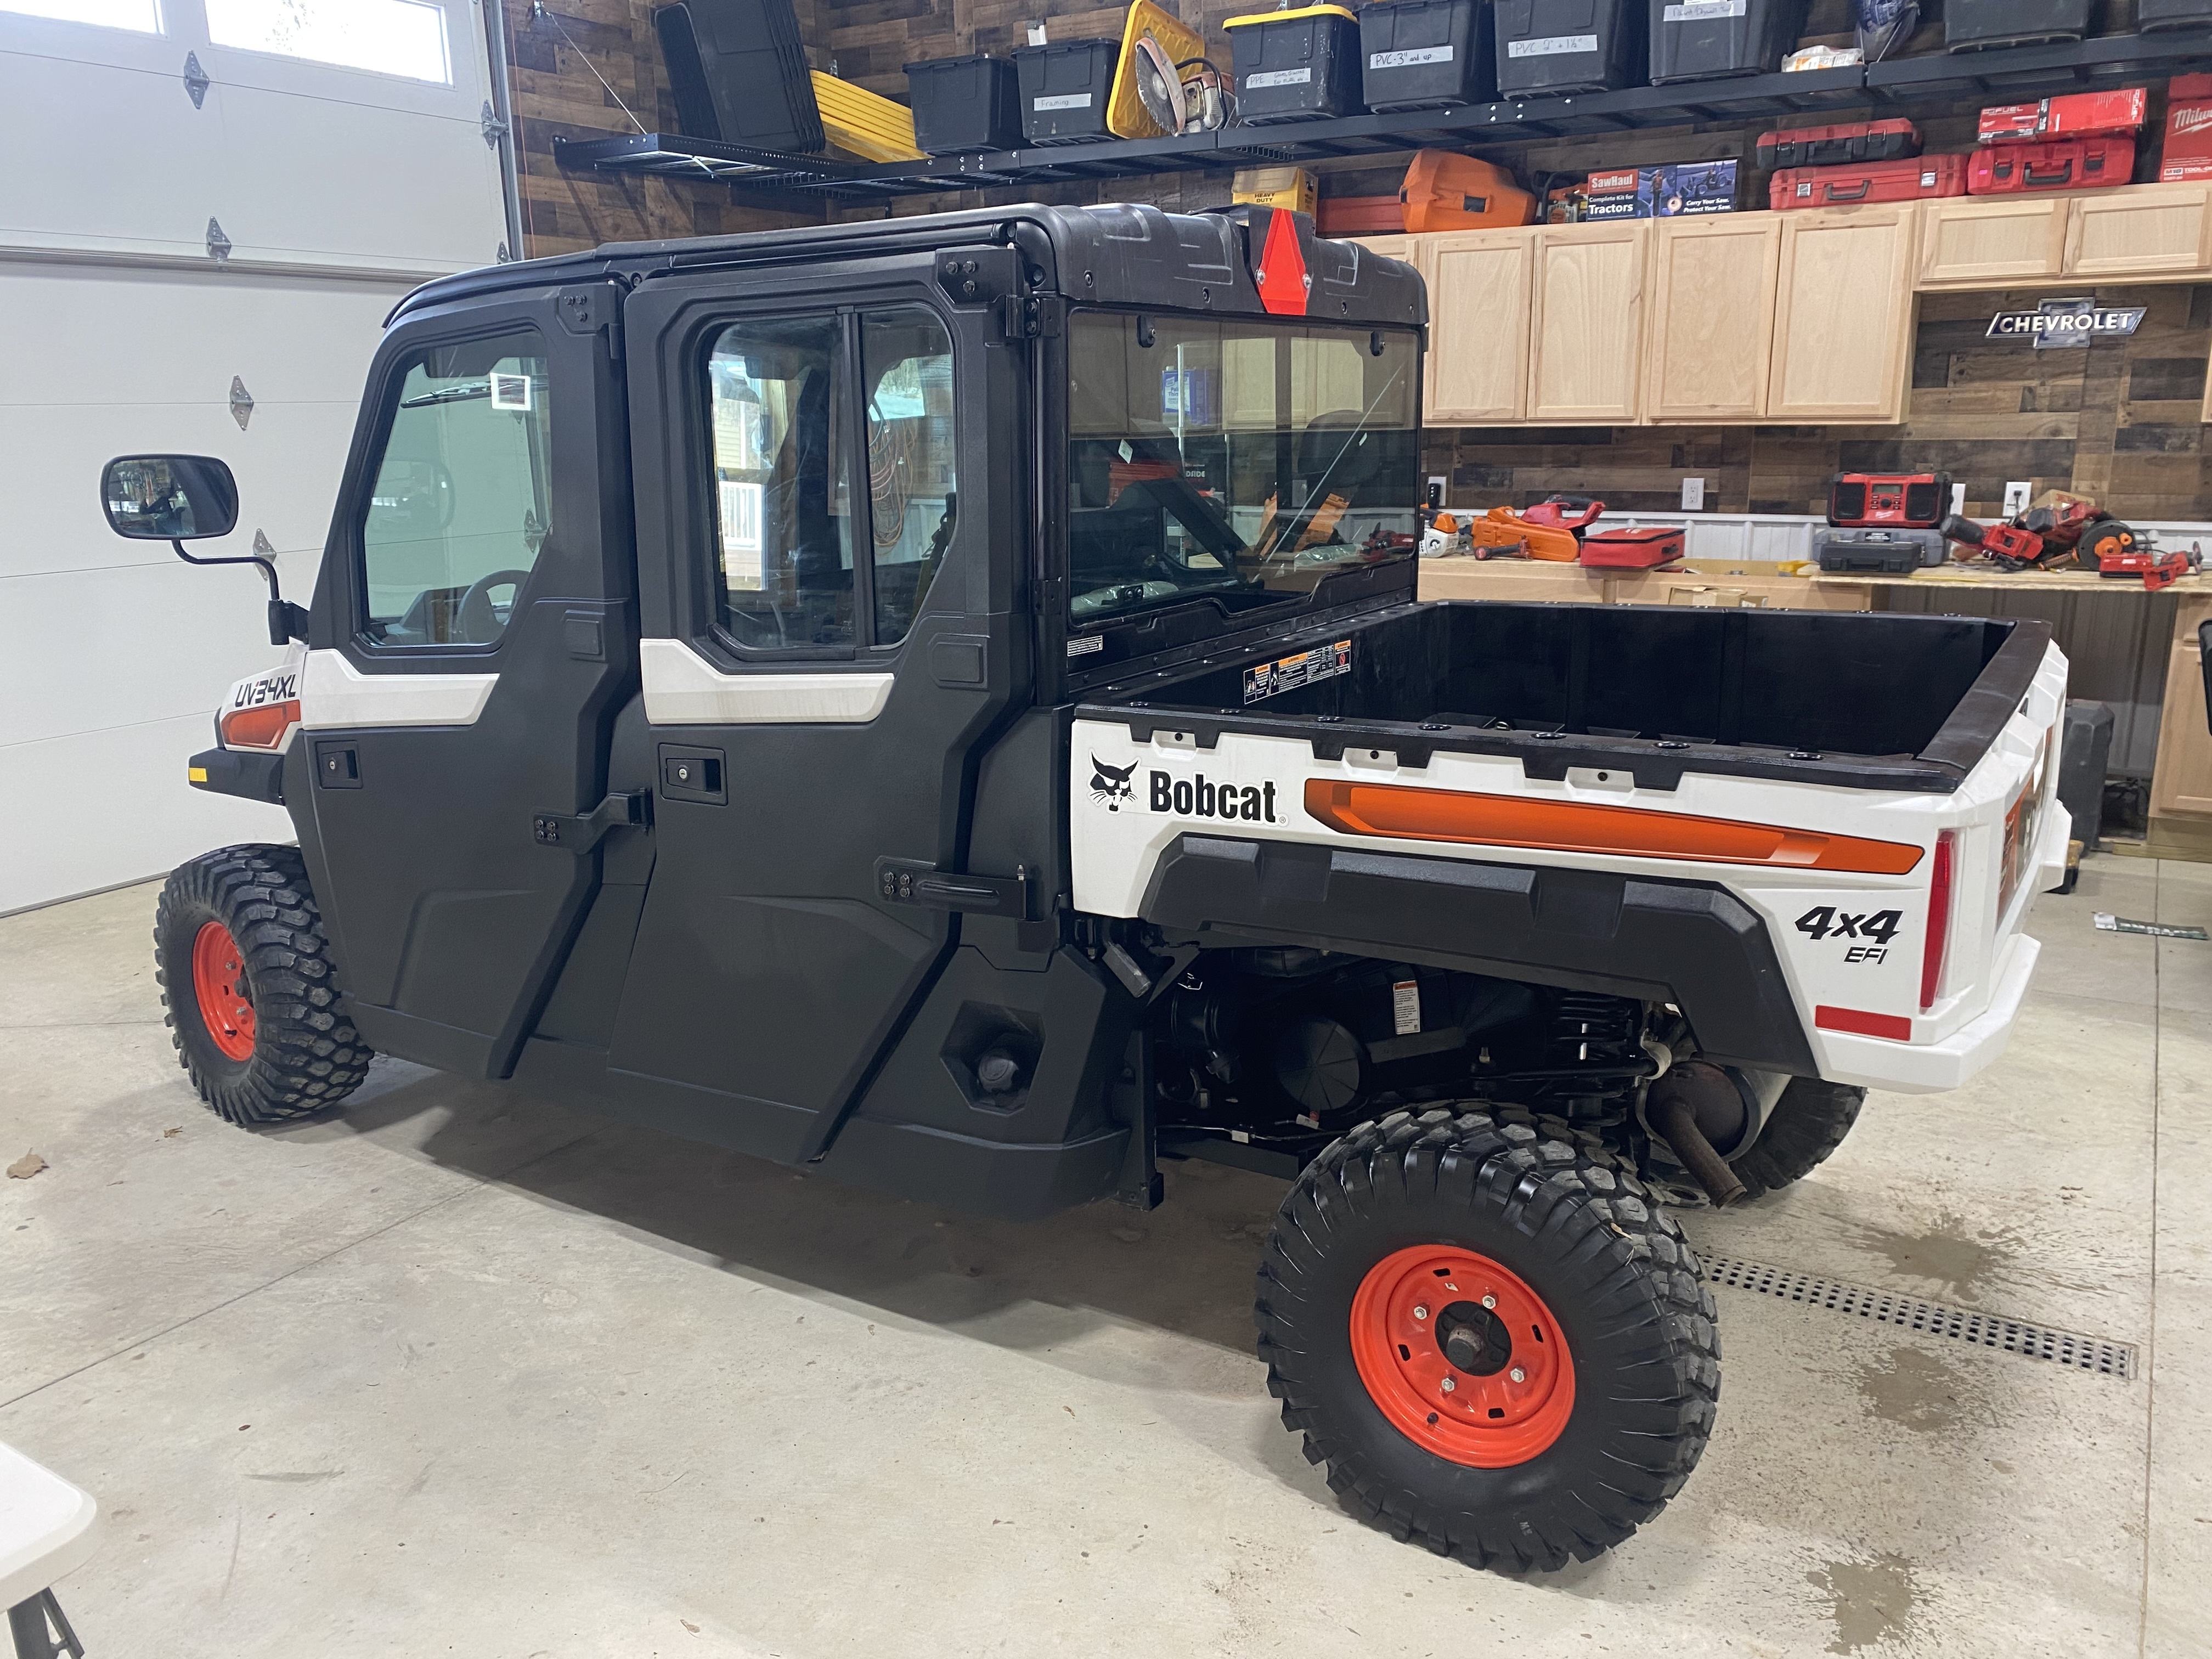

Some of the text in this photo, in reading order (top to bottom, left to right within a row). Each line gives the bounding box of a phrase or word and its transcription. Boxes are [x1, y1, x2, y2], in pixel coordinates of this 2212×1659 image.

[1250, 75, 1265, 85] PPE
[1592, 174, 1633, 188] SawHaul
[1588, 204, 1634, 215] Tractors
[2000, 313, 2133, 332] CHEVROLET
[235, 674, 296, 707] UV34XL
[1150, 770, 1276, 823] Bobcat
[1795, 905, 1904, 945] 4x4
[1843, 946, 1889, 964] EFI
